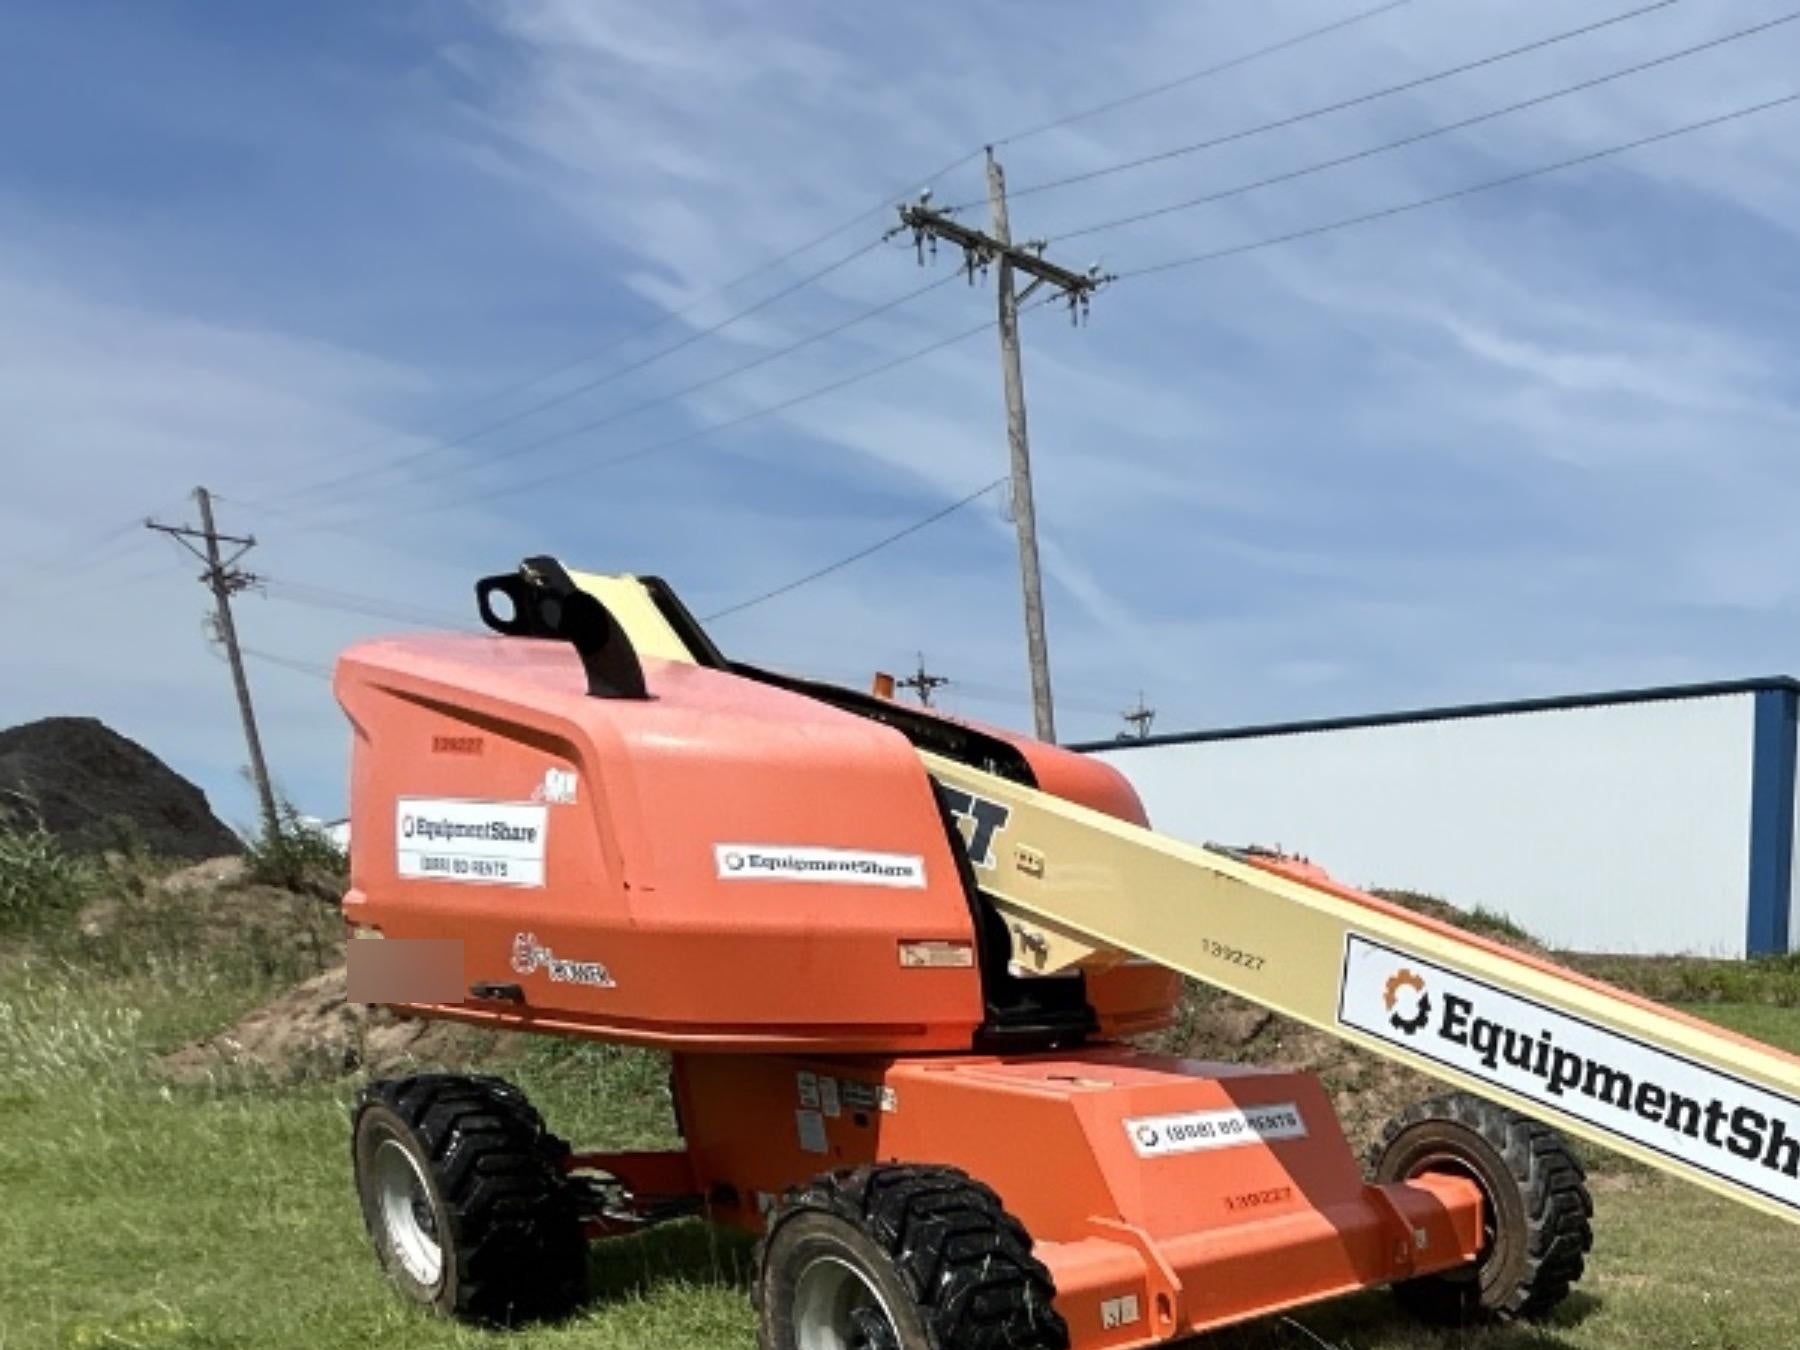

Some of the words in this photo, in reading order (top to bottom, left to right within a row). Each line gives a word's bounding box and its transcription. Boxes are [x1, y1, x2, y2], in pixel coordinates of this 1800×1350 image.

[416, 817, 537, 843] EquipmentShare
[747, 853, 914, 876] EquipmentShare
[1202, 938, 1265, 970] 139227
